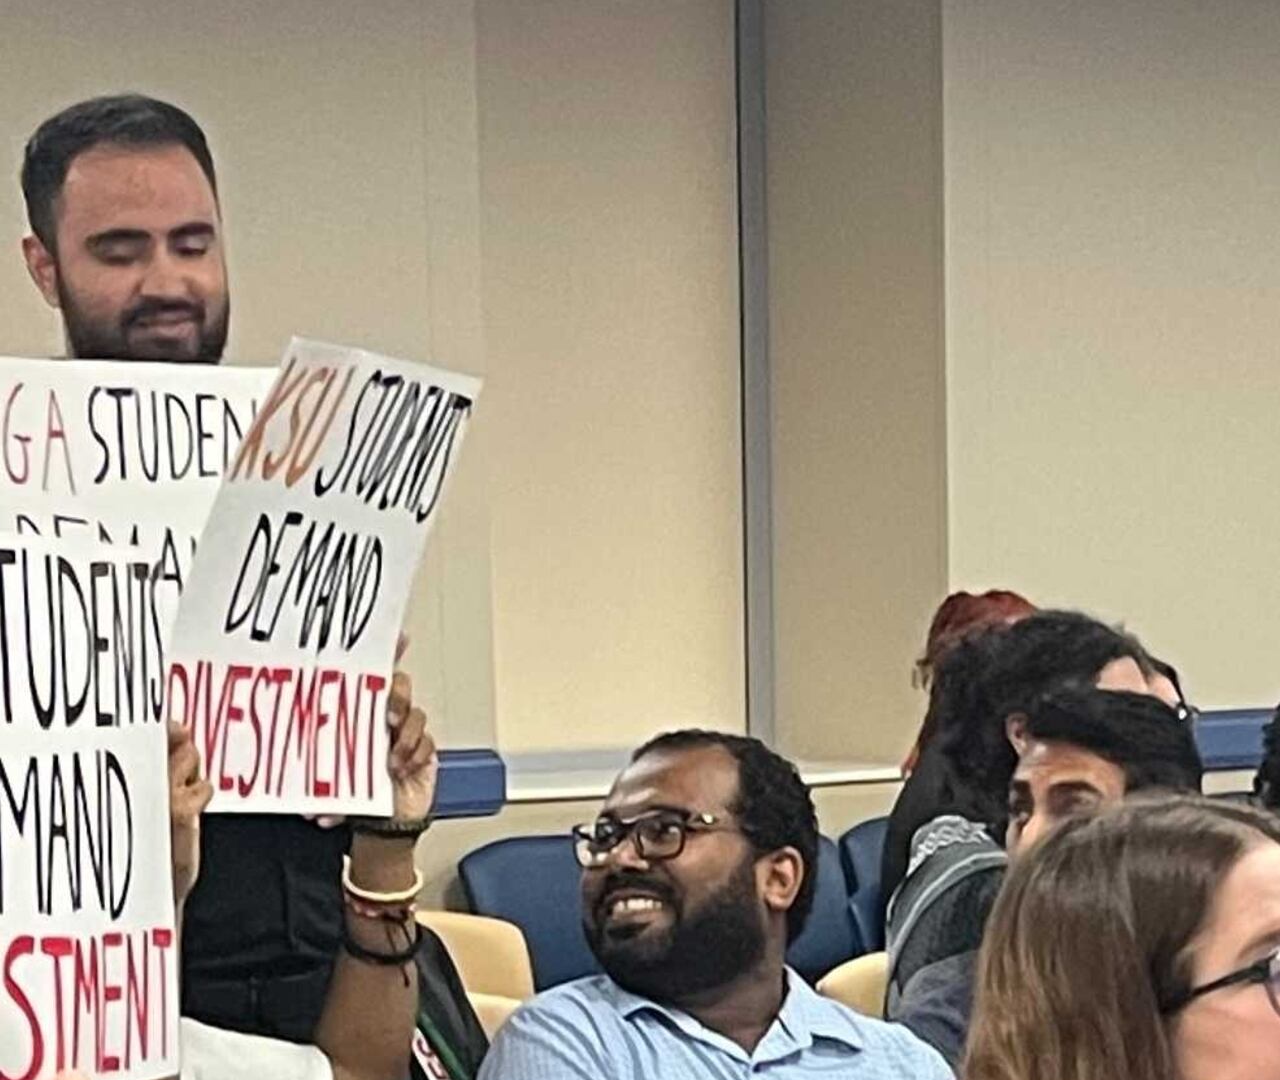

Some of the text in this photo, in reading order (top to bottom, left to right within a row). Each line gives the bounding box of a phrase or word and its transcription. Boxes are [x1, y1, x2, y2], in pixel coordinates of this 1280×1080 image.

[88, 386, 258, 484] STUDEN
[230, 357, 355, 488] KSU
[225, 511, 384, 651] DEMAND
